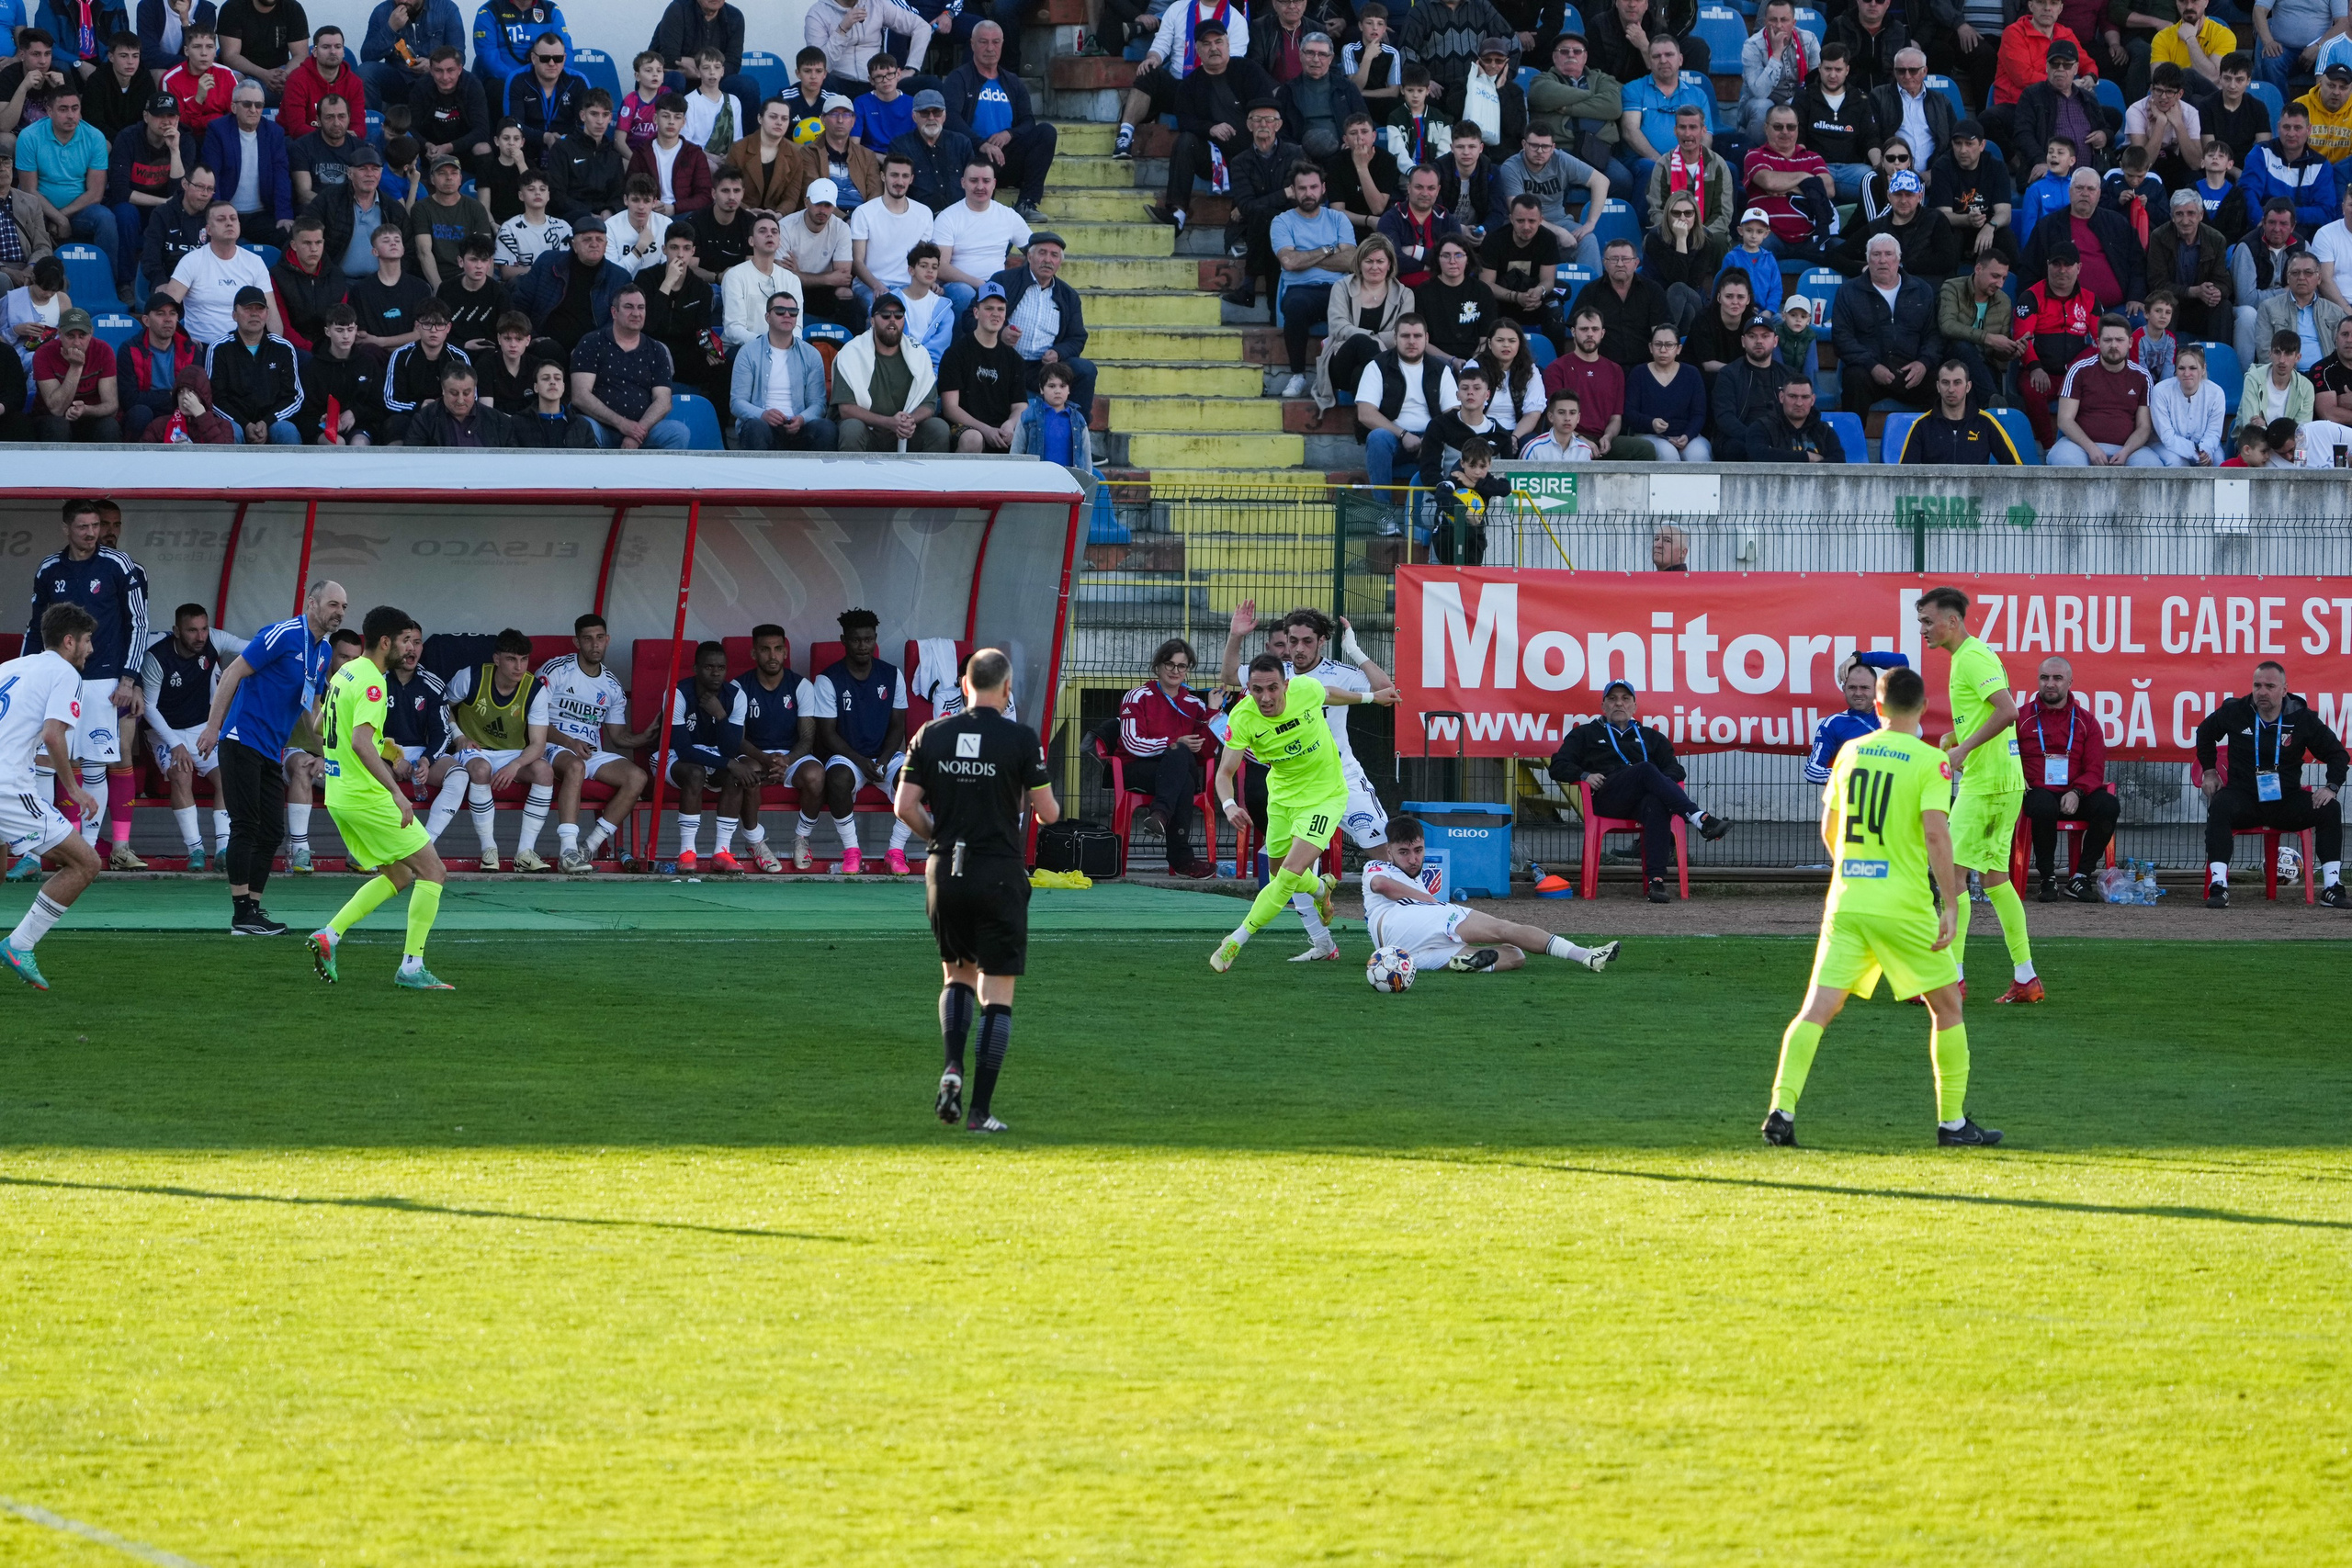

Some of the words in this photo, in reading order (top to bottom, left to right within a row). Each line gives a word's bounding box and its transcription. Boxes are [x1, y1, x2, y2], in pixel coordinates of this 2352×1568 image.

[1814, 120, 1844, 132] ellesse
[2202, 198, 2222, 211] NIKE
[1753, 316, 1762, 324] NY
[54, 580, 66, 592] 32
[1975, 594, 2146, 654] ZIARUL
[2161, 595, 2286, 655] CARE
[170, 677, 182, 687] 98
[475, 704, 487, 716] 70
[559, 698, 607, 719] UNIBET
[749, 705, 761, 718] 10
[482, 725, 508, 739] adidas
[1306, 739, 1320, 754] BET
[938, 760, 997, 777] NORDIS
[1845, 768, 1894, 846] 24
[1308, 814, 1329, 836] 30
[1447, 828, 1489, 839] IGLOO
